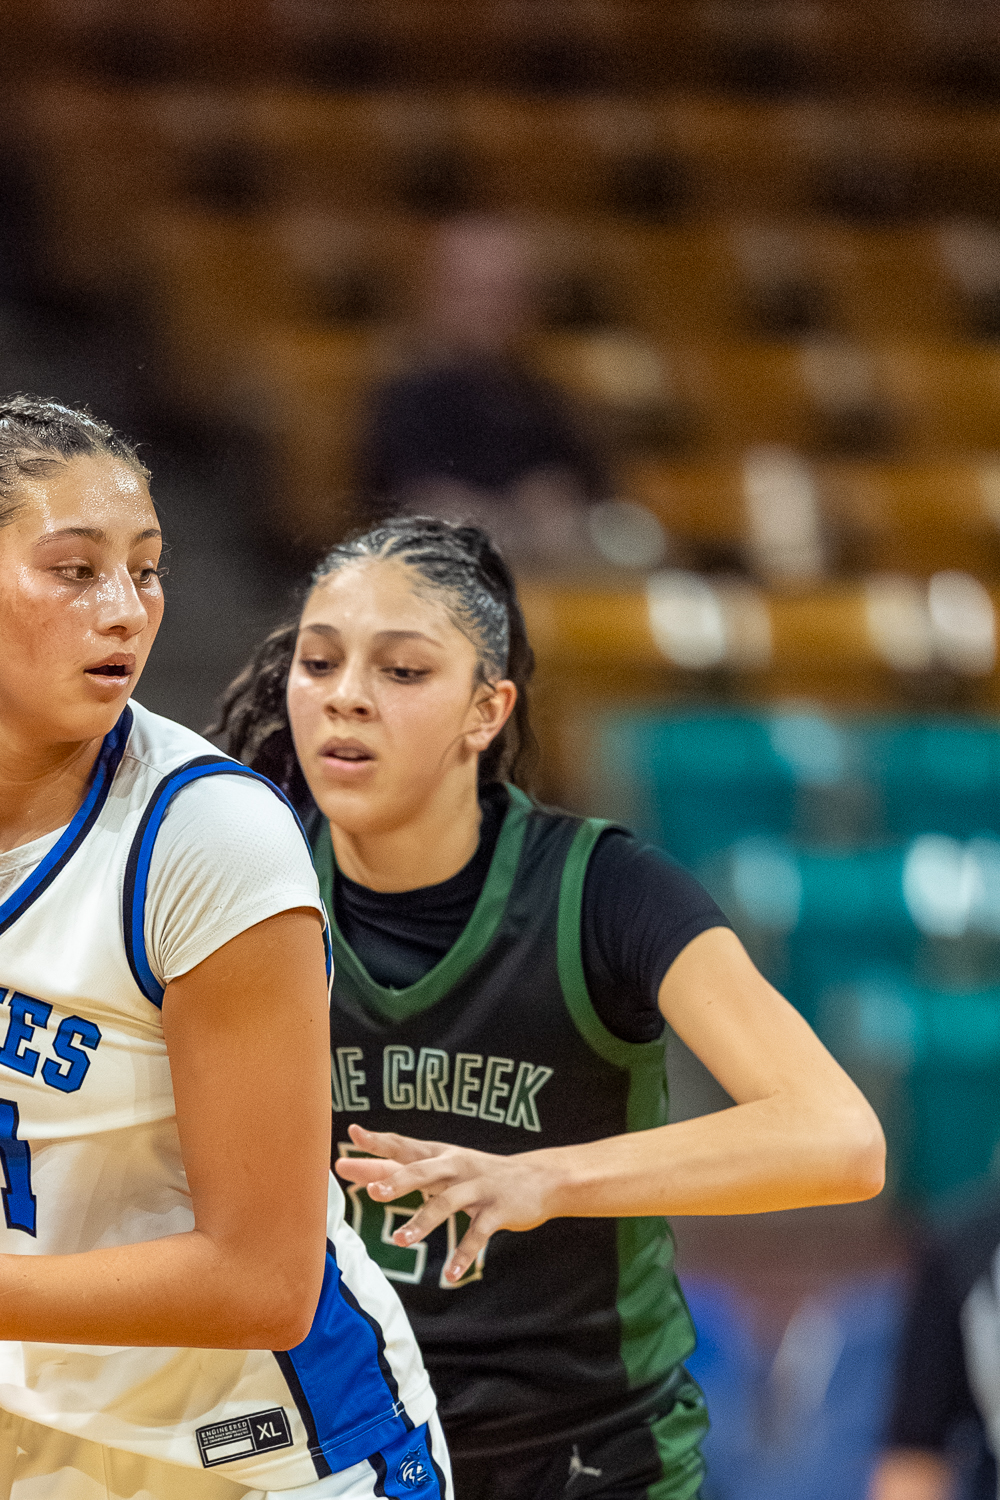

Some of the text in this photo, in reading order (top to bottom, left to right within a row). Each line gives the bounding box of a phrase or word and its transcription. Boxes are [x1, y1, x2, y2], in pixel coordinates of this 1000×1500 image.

[382, 1044, 554, 1133] CREEK
[201, 1421, 248, 1438] ENGINEERED
[256, 1421, 282, 1441] XL
